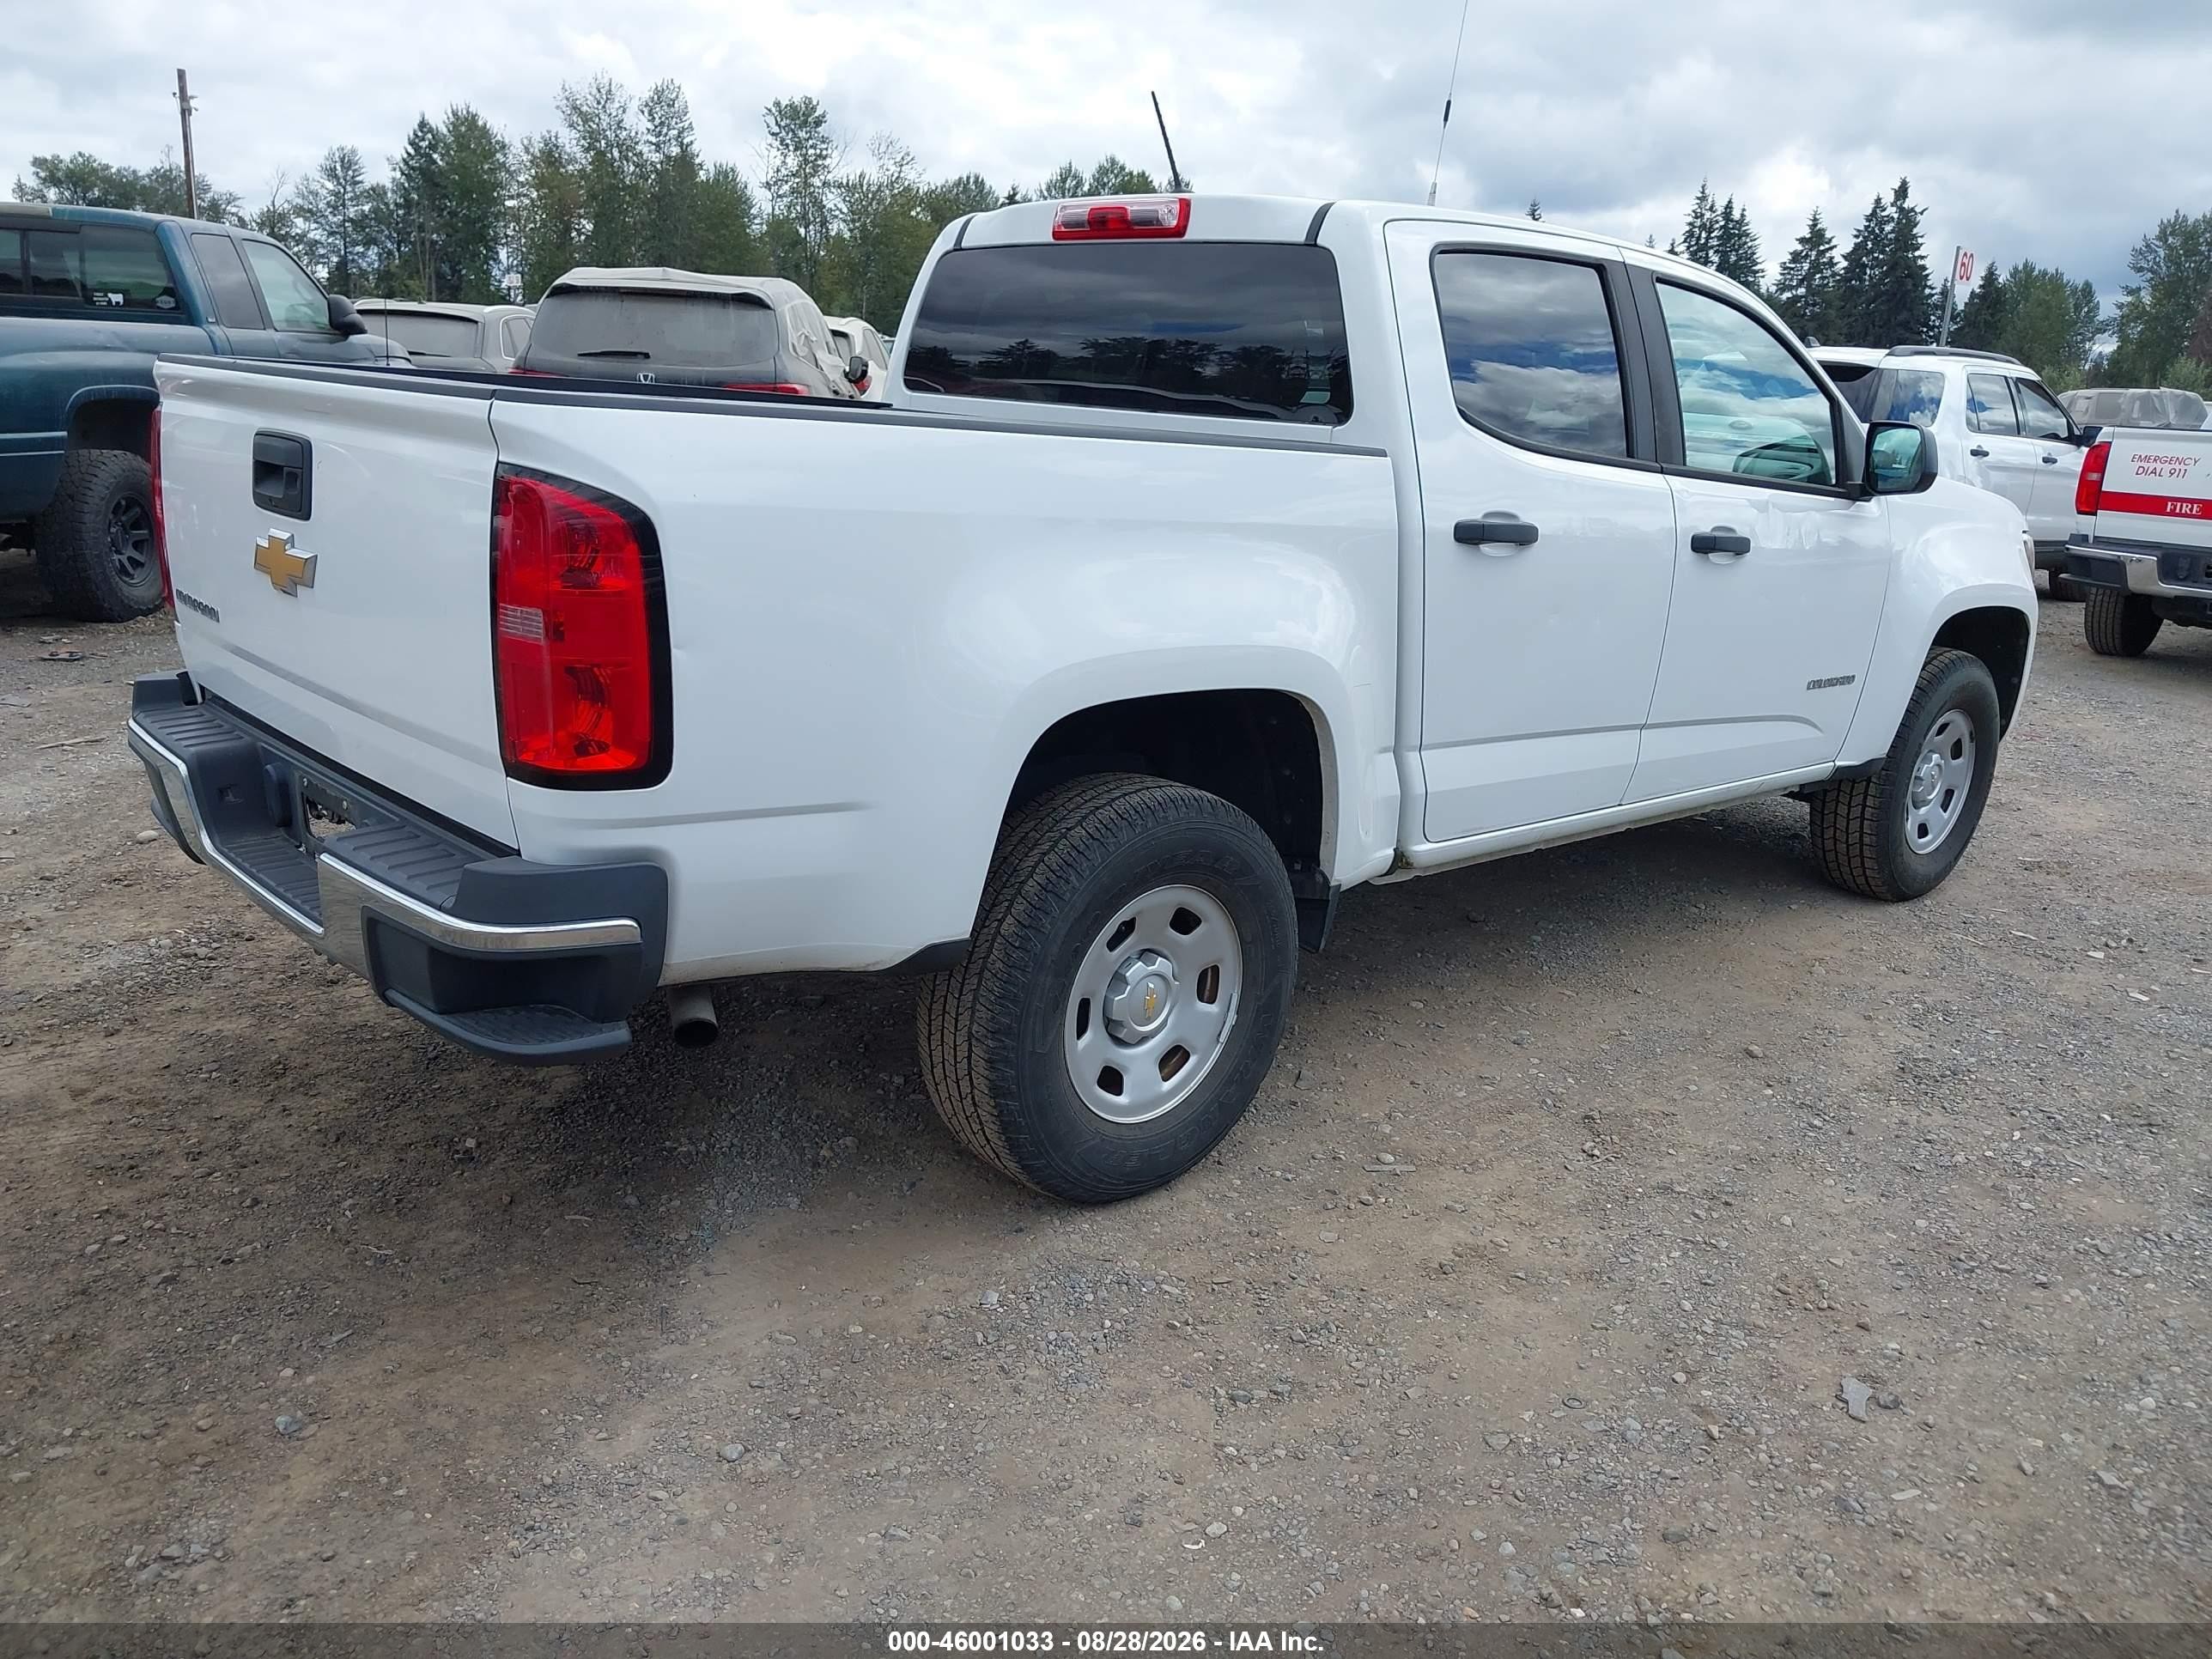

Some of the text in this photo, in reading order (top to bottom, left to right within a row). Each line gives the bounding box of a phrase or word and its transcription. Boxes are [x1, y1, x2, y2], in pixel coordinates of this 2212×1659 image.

[1959, 251, 1974, 282] 60
[2130, 453, 2201, 466] EMERGENCY
[2136, 466, 2187, 478] DIAL 911
[2166, 501, 2203, 515] FIRE
